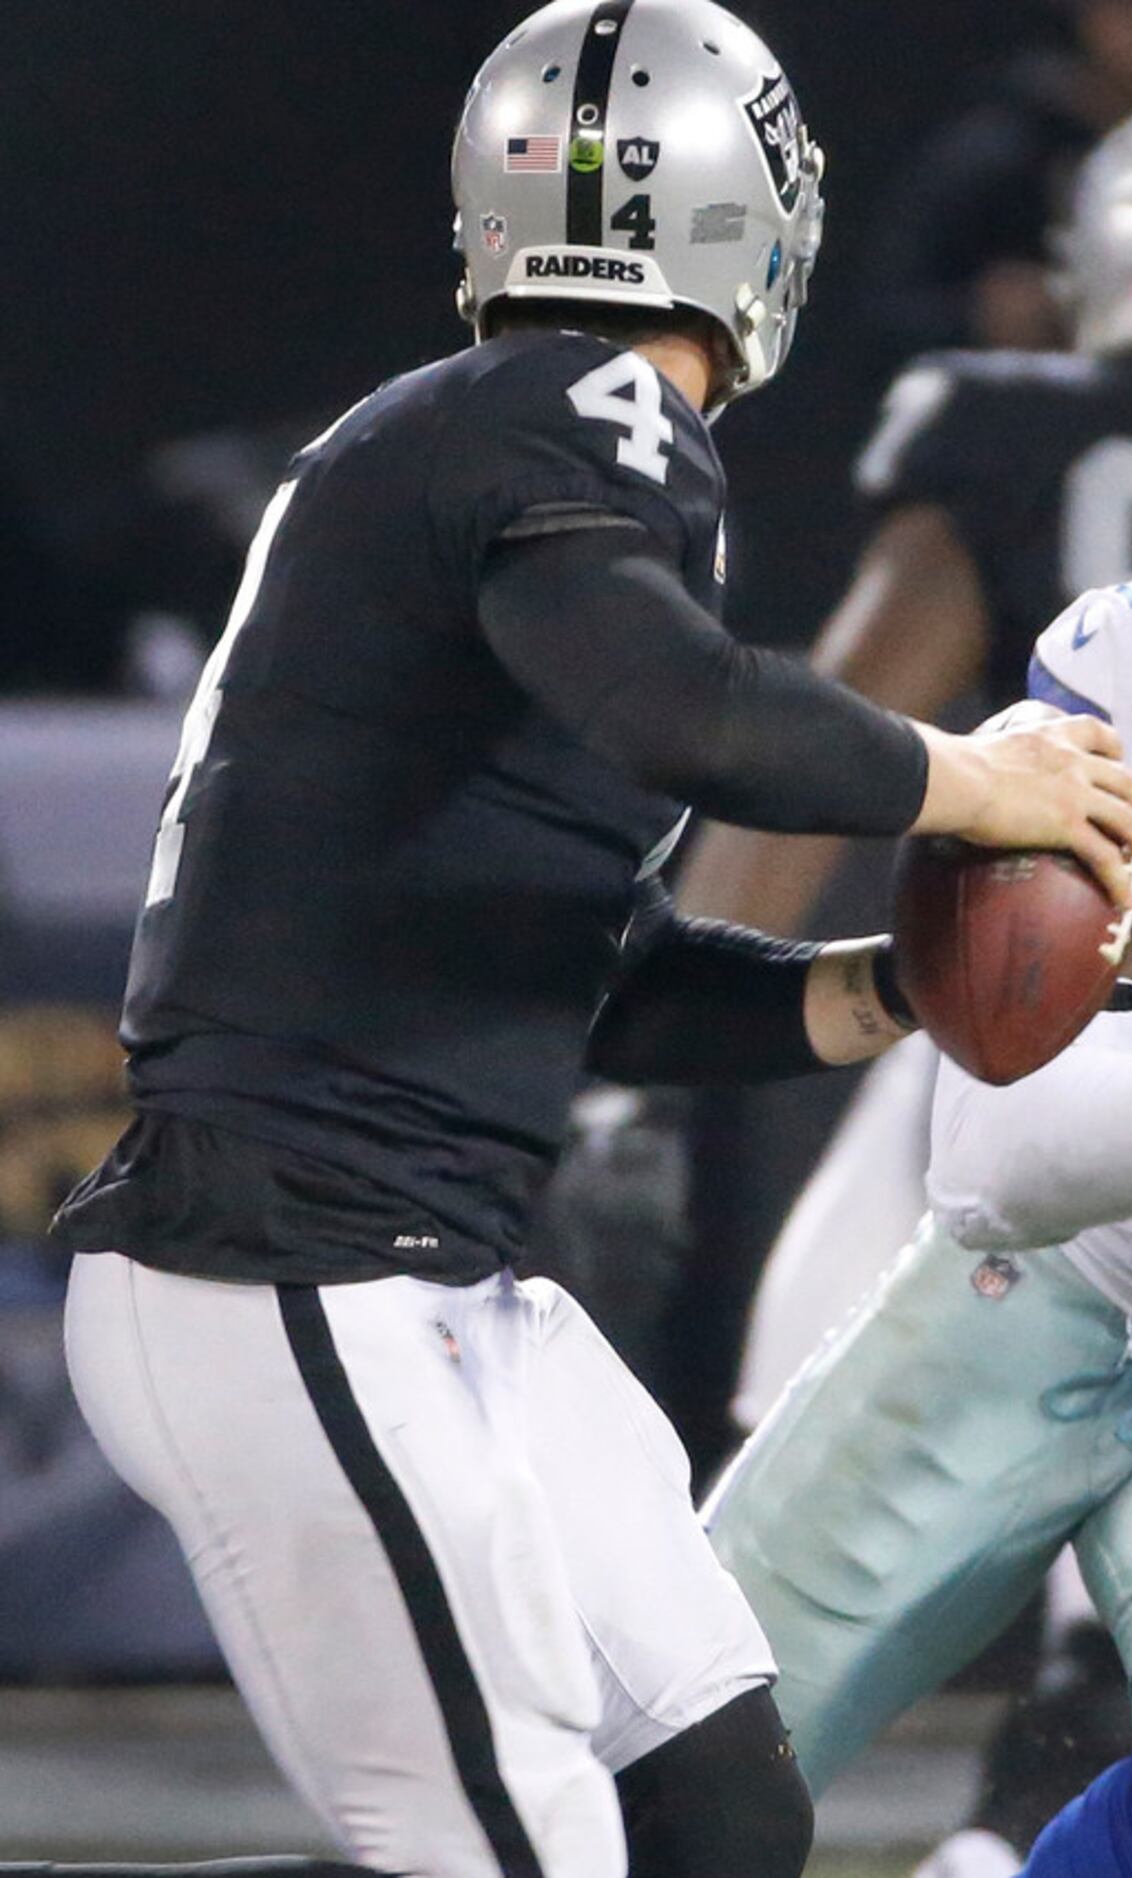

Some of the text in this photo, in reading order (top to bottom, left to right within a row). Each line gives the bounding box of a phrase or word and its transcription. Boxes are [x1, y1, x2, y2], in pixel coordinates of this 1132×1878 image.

[621, 144, 655, 166] AL
[610, 193, 656, 250] 4
[525, 256, 645, 284] RAIDERS
[565, 351, 674, 486] 4
